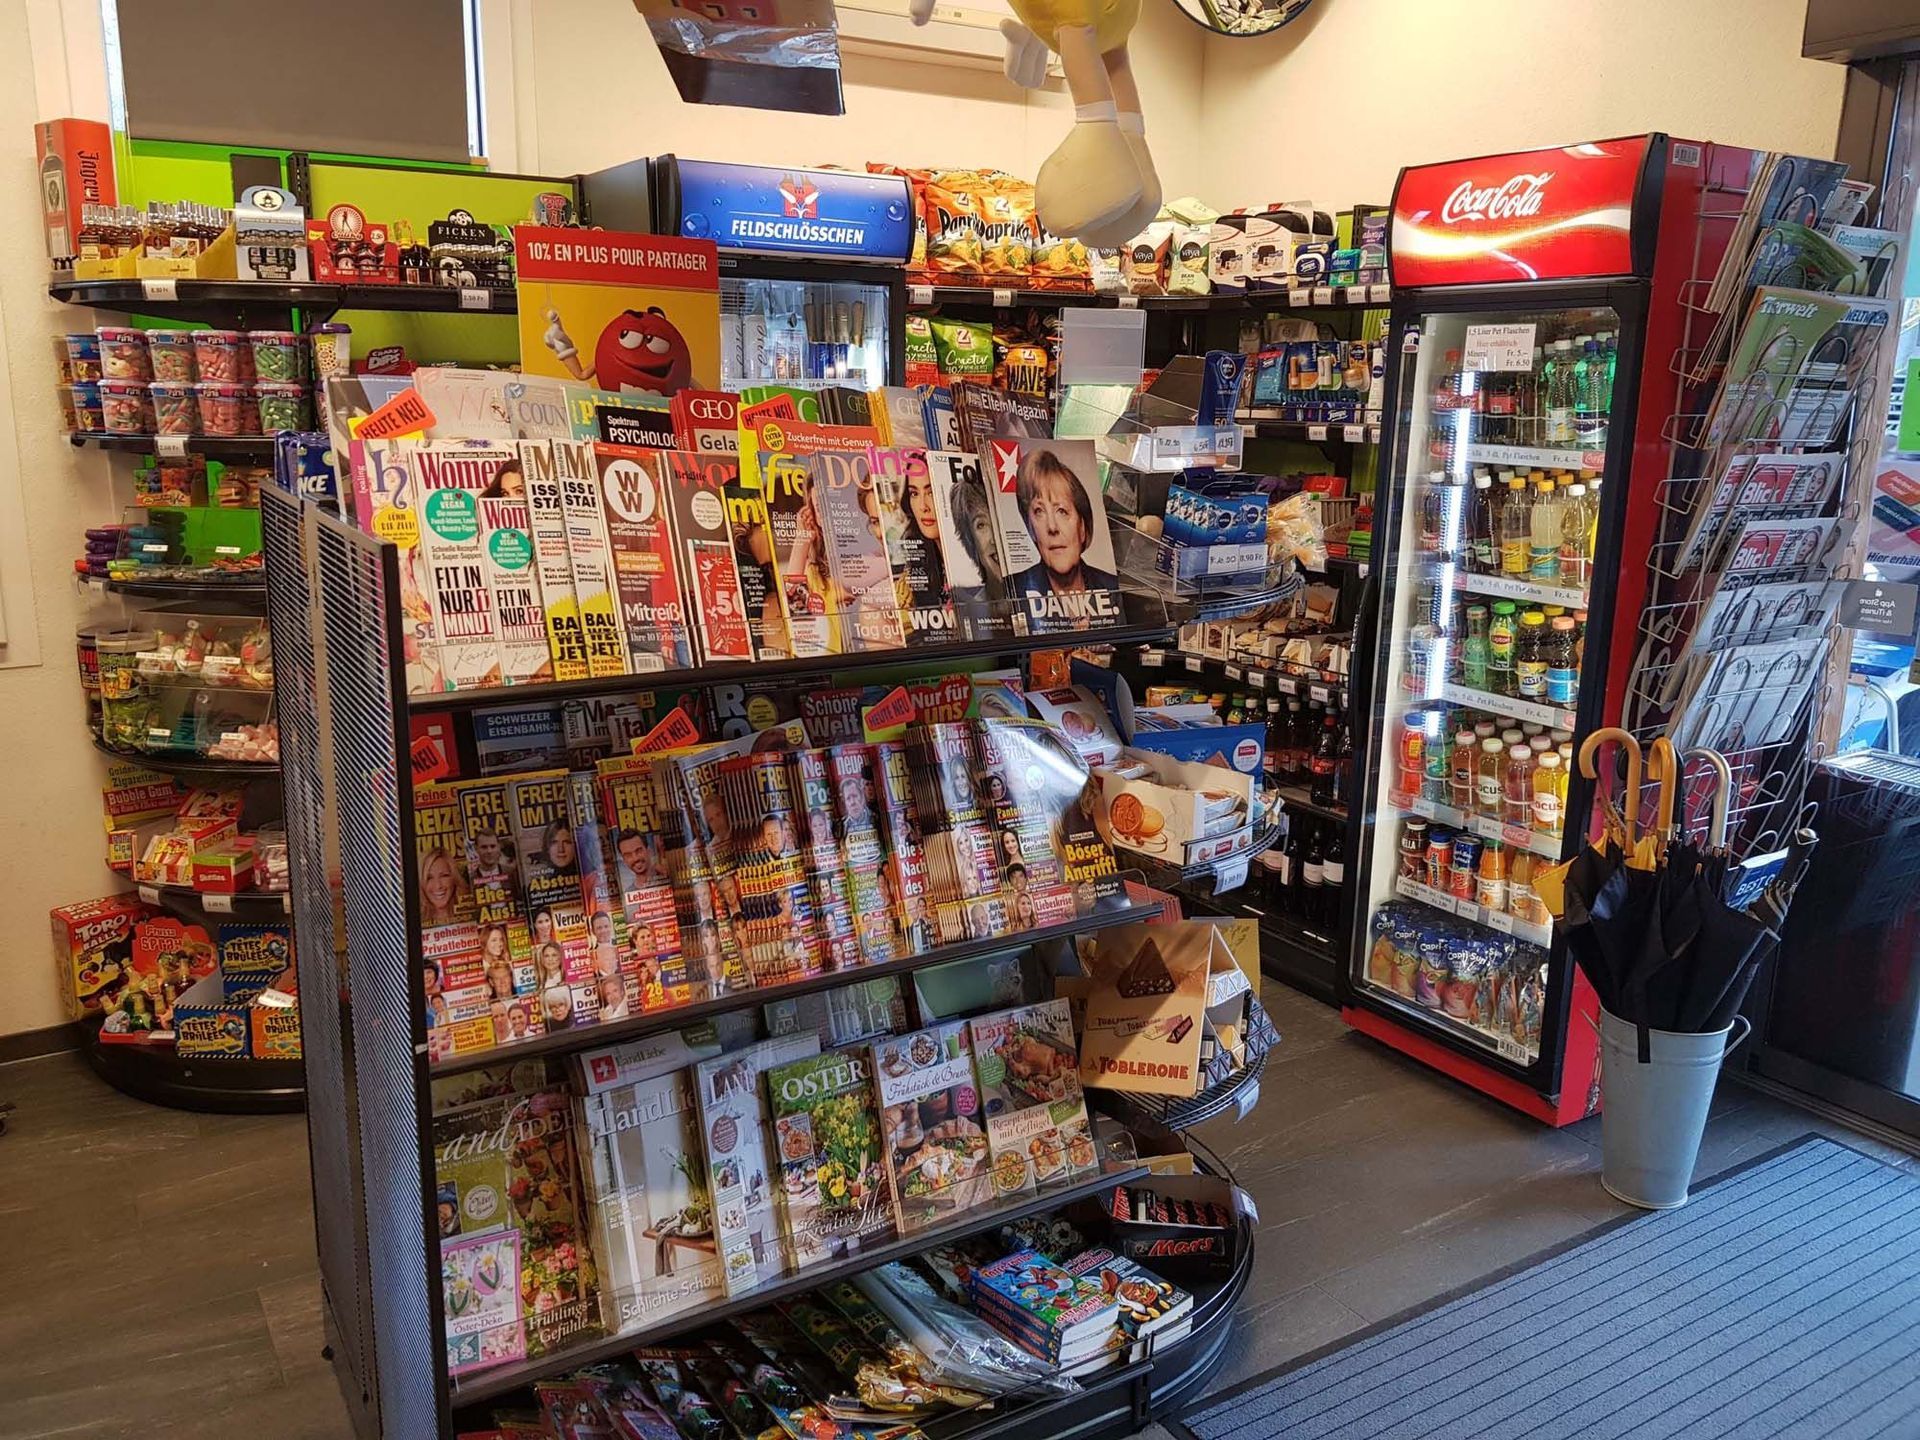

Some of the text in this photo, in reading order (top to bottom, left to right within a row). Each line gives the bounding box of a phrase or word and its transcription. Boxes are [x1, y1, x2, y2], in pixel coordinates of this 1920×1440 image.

[1441, 171, 1557, 224] Coca-Cola
[438, 226, 486, 238] FICKEN
[732, 219, 864, 245] FELDSCHLÖSSCHEN
[527, 242, 707, 271] 10% EN PLUS POUR PARTAGER
[1492, 327, 1502, 335] Pet
[1503, 326, 1530, 335] Flaschen
[368, 354, 401, 370] DIPS
[1006, 365, 1046, 396] WAVE
[359, 396, 427, 439] HEUTE NEU
[689, 397, 735, 421] GEO
[606, 414, 640, 428] Spektrum
[786, 431, 874, 447] Zuckerfrei mit Genuss
[563, 481, 584, 493] ISS
[1742, 481, 1780, 504] Blick
[831, 509, 848, 518] Mode
[1734, 549, 1771, 568] Blick
[1867, 552, 1887, 563] Hier
[434, 565, 483, 589] FIT IN
[439, 590, 473, 612] NUR
[496, 588, 532, 607] FIT IN
[1025, 588, 1121, 619] DANKE.
[499, 606, 543, 626] NUR 12
[854, 622, 881, 640] Tag
[805, 694, 859, 716] Schöne
[910, 684, 971, 711] Nur für
[1164, 694, 1181, 706] TUC
[486, 711, 551, 726] SCHWEIZER
[870, 698, 911, 726] HEUTE NEU
[924, 701, 965, 724] uns
[669, 718, 690, 742] NEU
[807, 717, 860, 738] Welt
[412, 747, 439, 774] NEU
[107, 785, 173, 806] Bubble Gum
[521, 809, 545, 828] IM
[898, 843, 916, 859] Die
[1065, 842, 1106, 862] Böser
[1064, 856, 1119, 881] Angriff!
[474, 885, 512, 905] Ehe-
[905, 880, 923, 896] des
[479, 901, 516, 924] Aus!
[77, 914, 127, 942] TORO
[83, 931, 118, 951] BALLS
[646, 982, 664, 997] 28
[1099, 1056, 1191, 1080] TOBLERONE
[887, 1075, 931, 1101] Frühstück
[991, 1109, 1046, 1131] Rezept-Ideen
[999, 1119, 1051, 1140] mit Geflügel
[1150, 1237, 1214, 1257] Mars
[621, 1288, 680, 1321] Schlichte
[453, 1316, 504, 1335] Oster-Deko
[528, 1302, 594, 1332] Frühlings-
[539, 1318, 589, 1345] Gefühle
